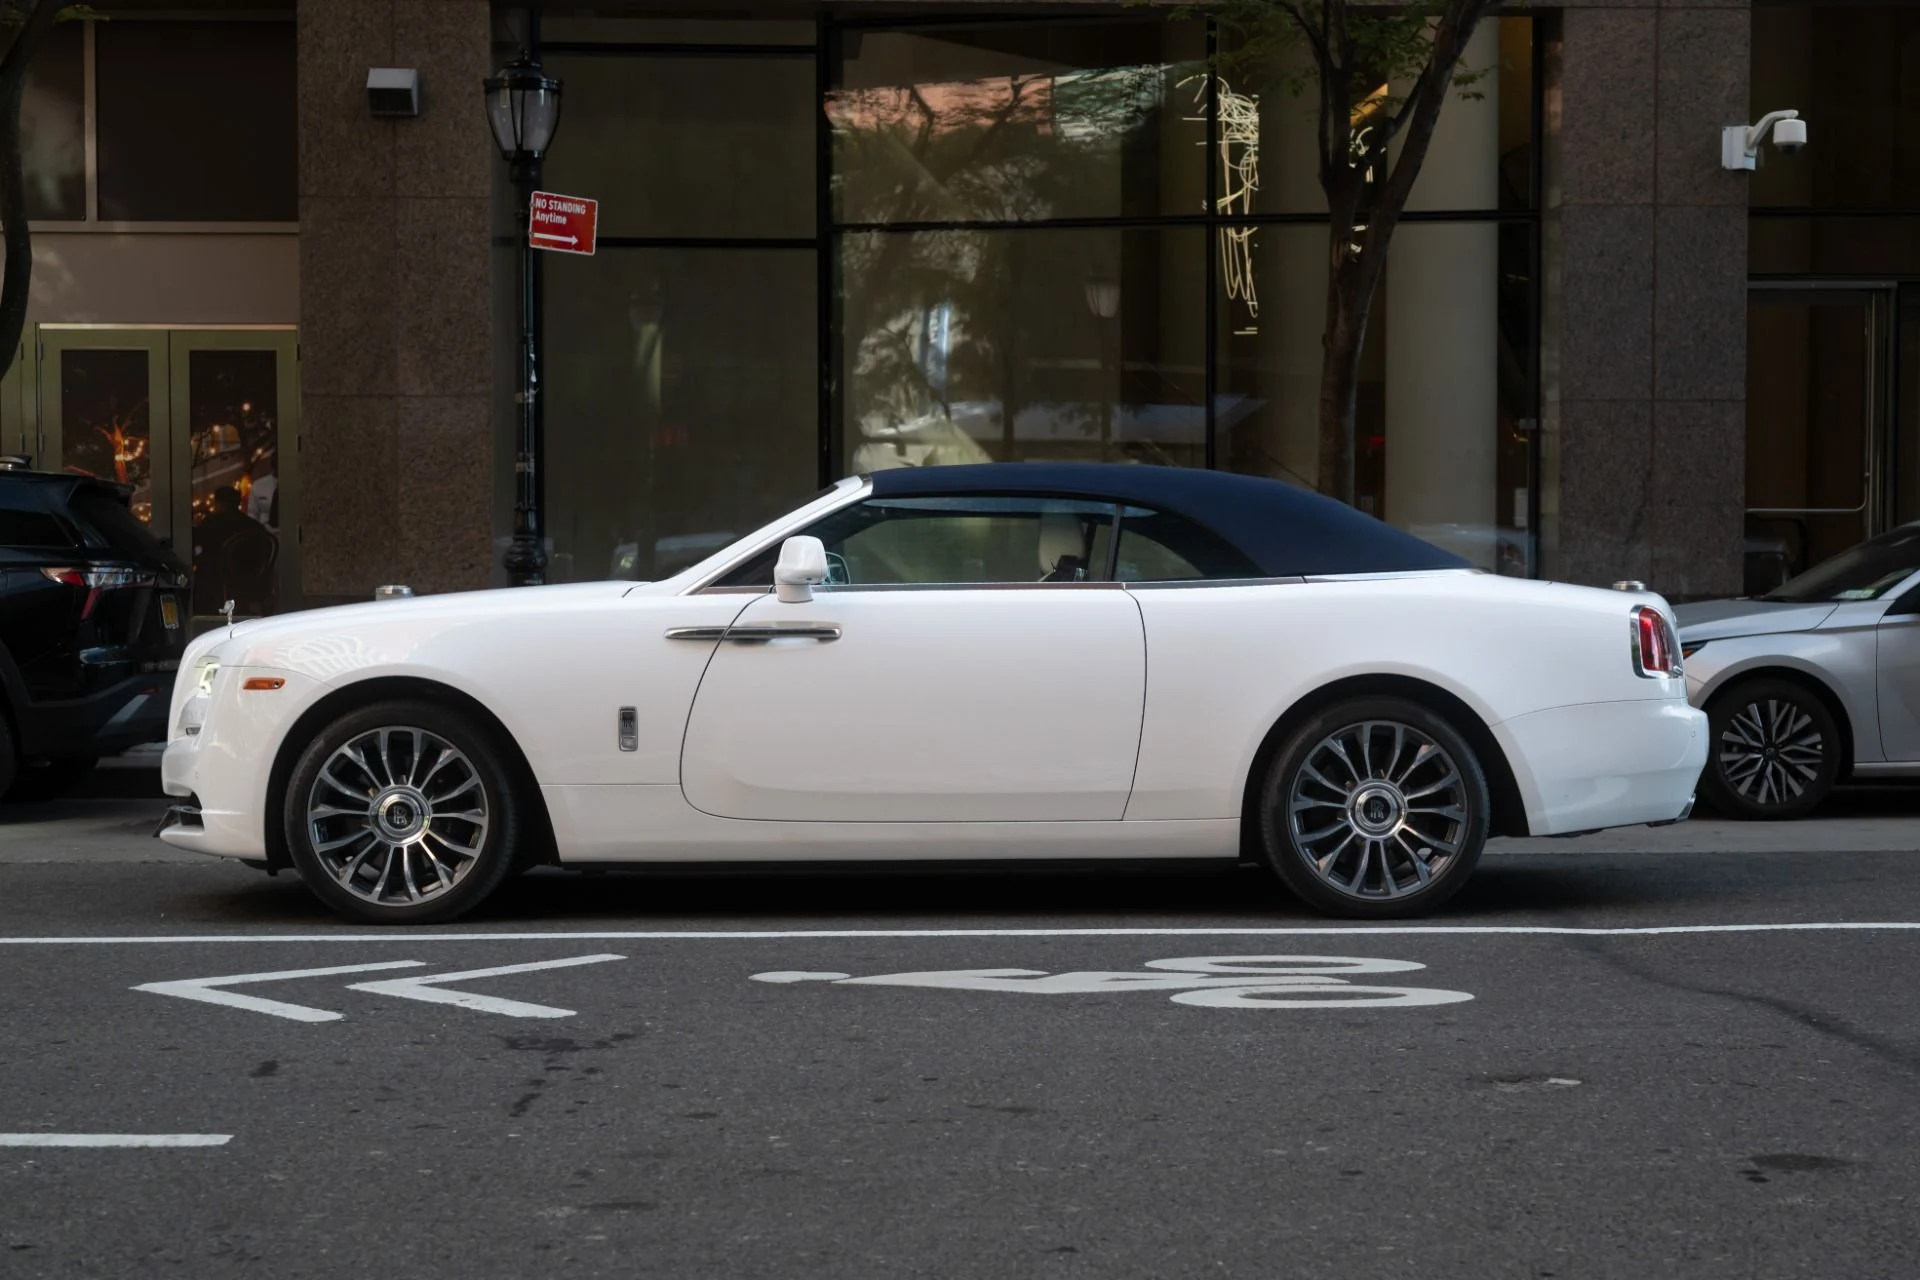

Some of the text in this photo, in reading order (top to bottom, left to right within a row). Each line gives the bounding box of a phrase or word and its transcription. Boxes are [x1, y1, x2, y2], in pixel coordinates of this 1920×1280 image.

[535, 198, 586, 215] NO STANDING
[535, 210, 567, 225] Anytime
